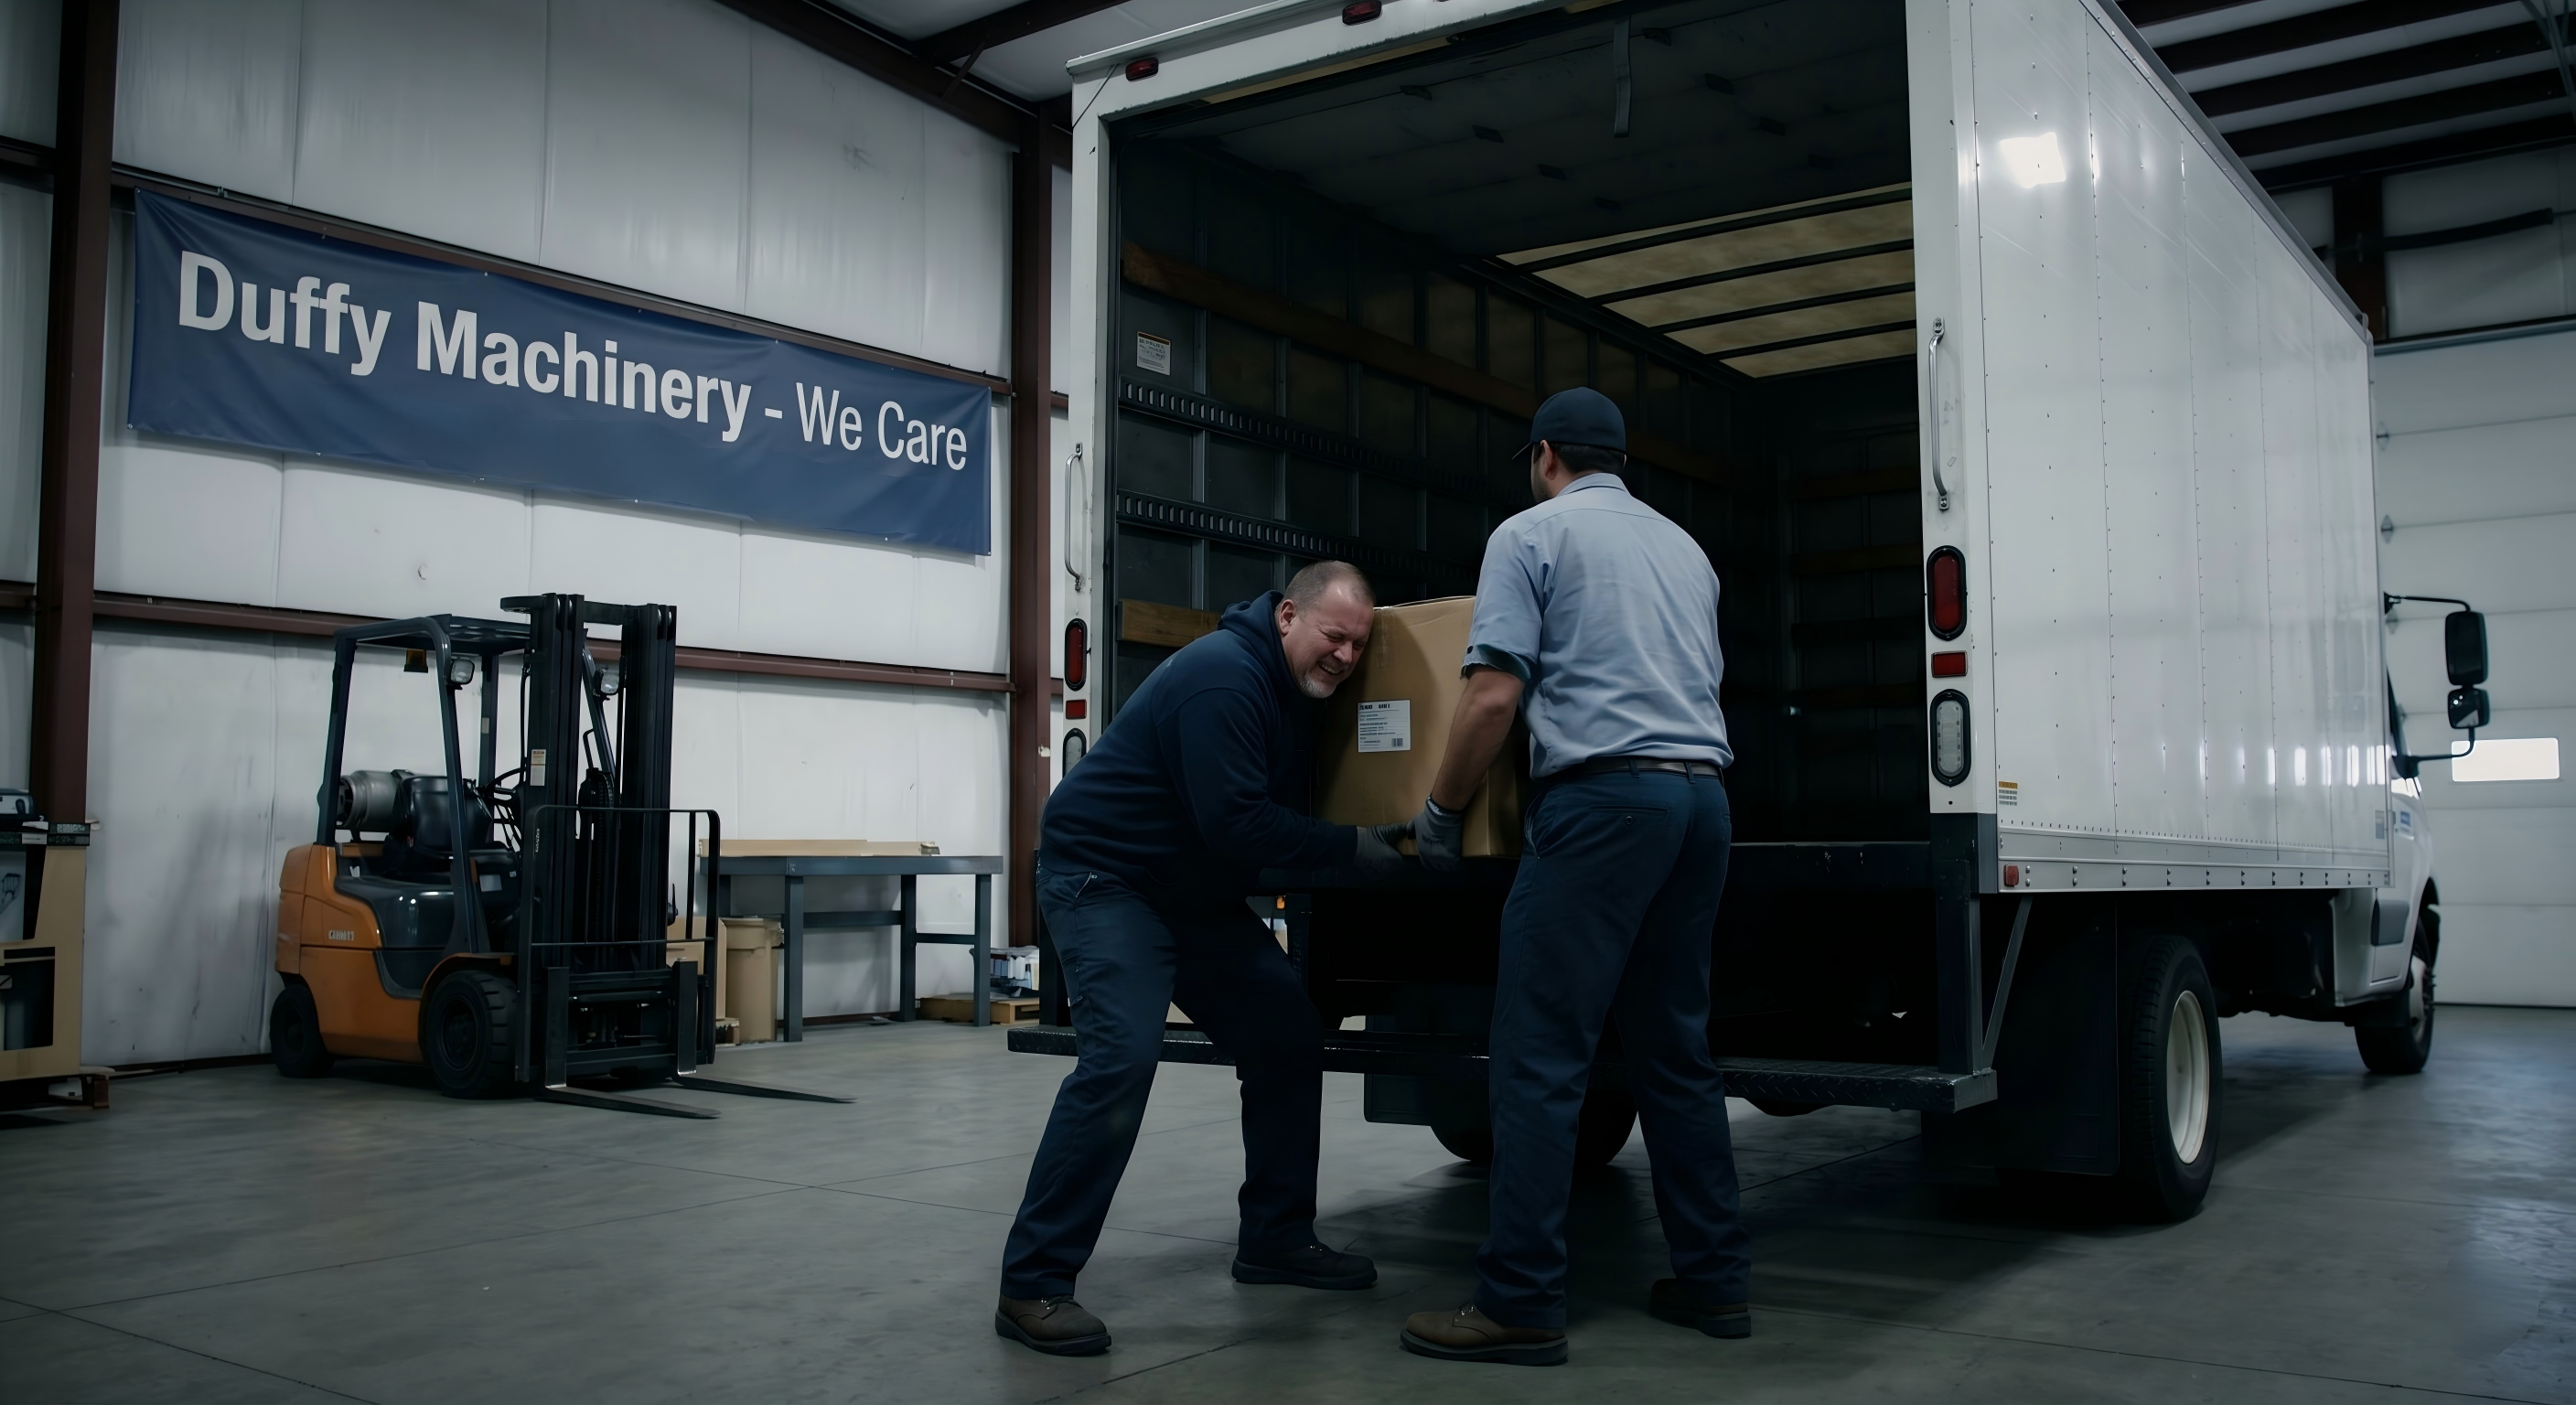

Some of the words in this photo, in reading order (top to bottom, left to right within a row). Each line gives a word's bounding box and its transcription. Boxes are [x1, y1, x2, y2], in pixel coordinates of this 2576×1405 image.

[178, 251, 392, 376] Duffy
[416, 301, 752, 443] Machinery
[764, 407, 783, 420] -
[795, 381, 863, 451] We
[876, 400, 968, 471] Care
